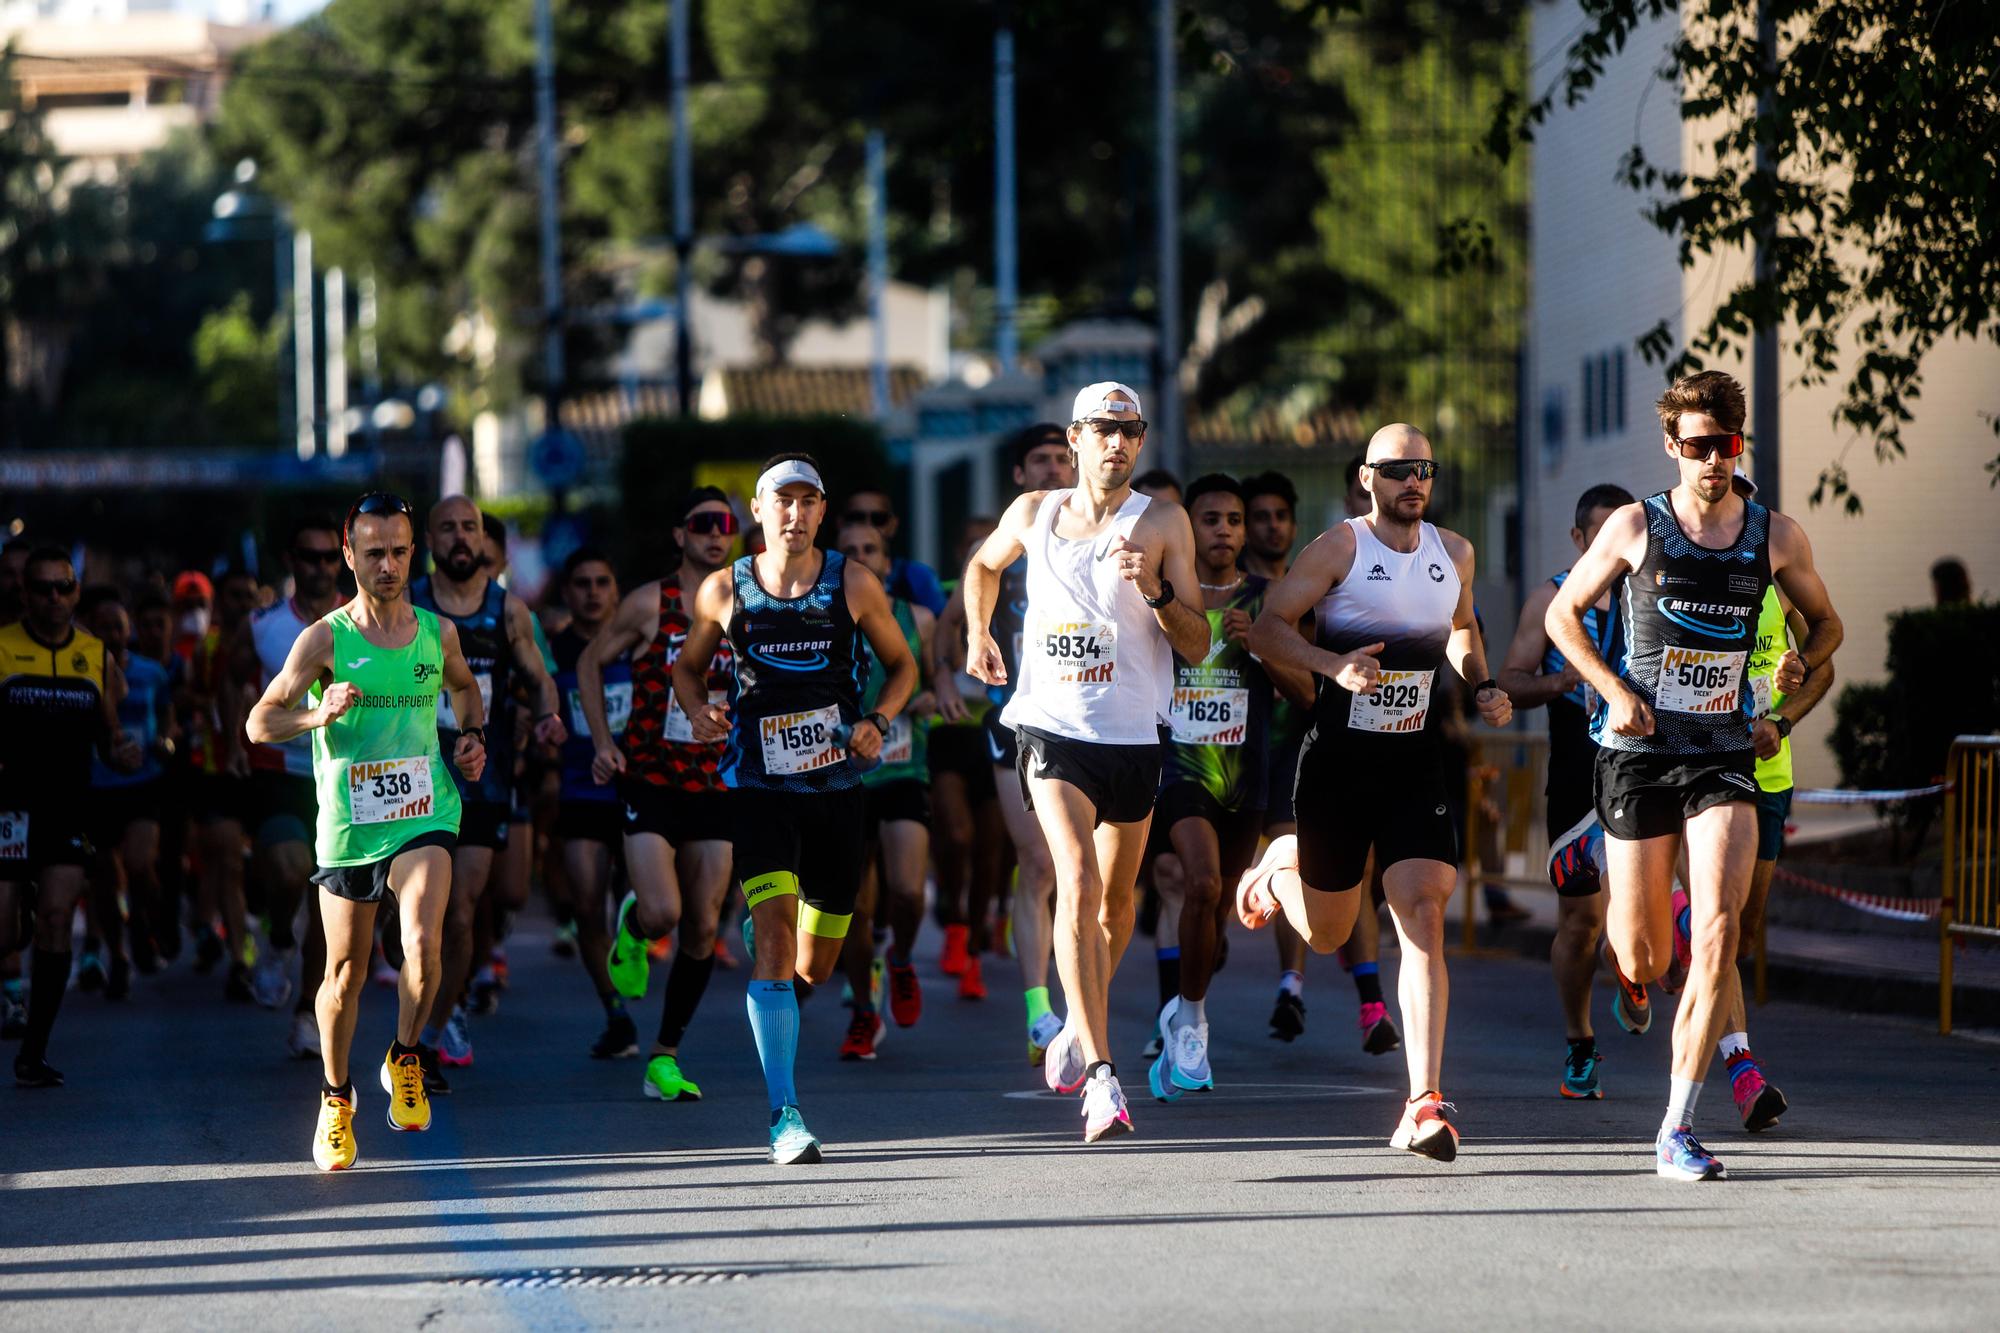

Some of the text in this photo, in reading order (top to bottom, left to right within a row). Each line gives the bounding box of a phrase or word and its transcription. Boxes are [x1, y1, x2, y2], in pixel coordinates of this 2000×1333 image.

[1670, 600, 1753, 616] METAESPORT
[759, 640, 832, 653] METAESPORT
[1046, 633, 1101, 659] 5934
[1180, 667, 1241, 678] CAIXA RURAL
[1678, 662, 1731, 690] 5065
[1369, 684, 1419, 708] 5929
[1693, 689, 1712, 698] VICENT
[1188, 700, 1231, 722] 1626
[1383, 709, 1403, 717] FRUTOS
[778, 722, 826, 750] 1588
[795, 748, 816, 757] SAMUEL
[371, 772, 413, 798] 338
[383, 797, 404, 806] ANDRES
